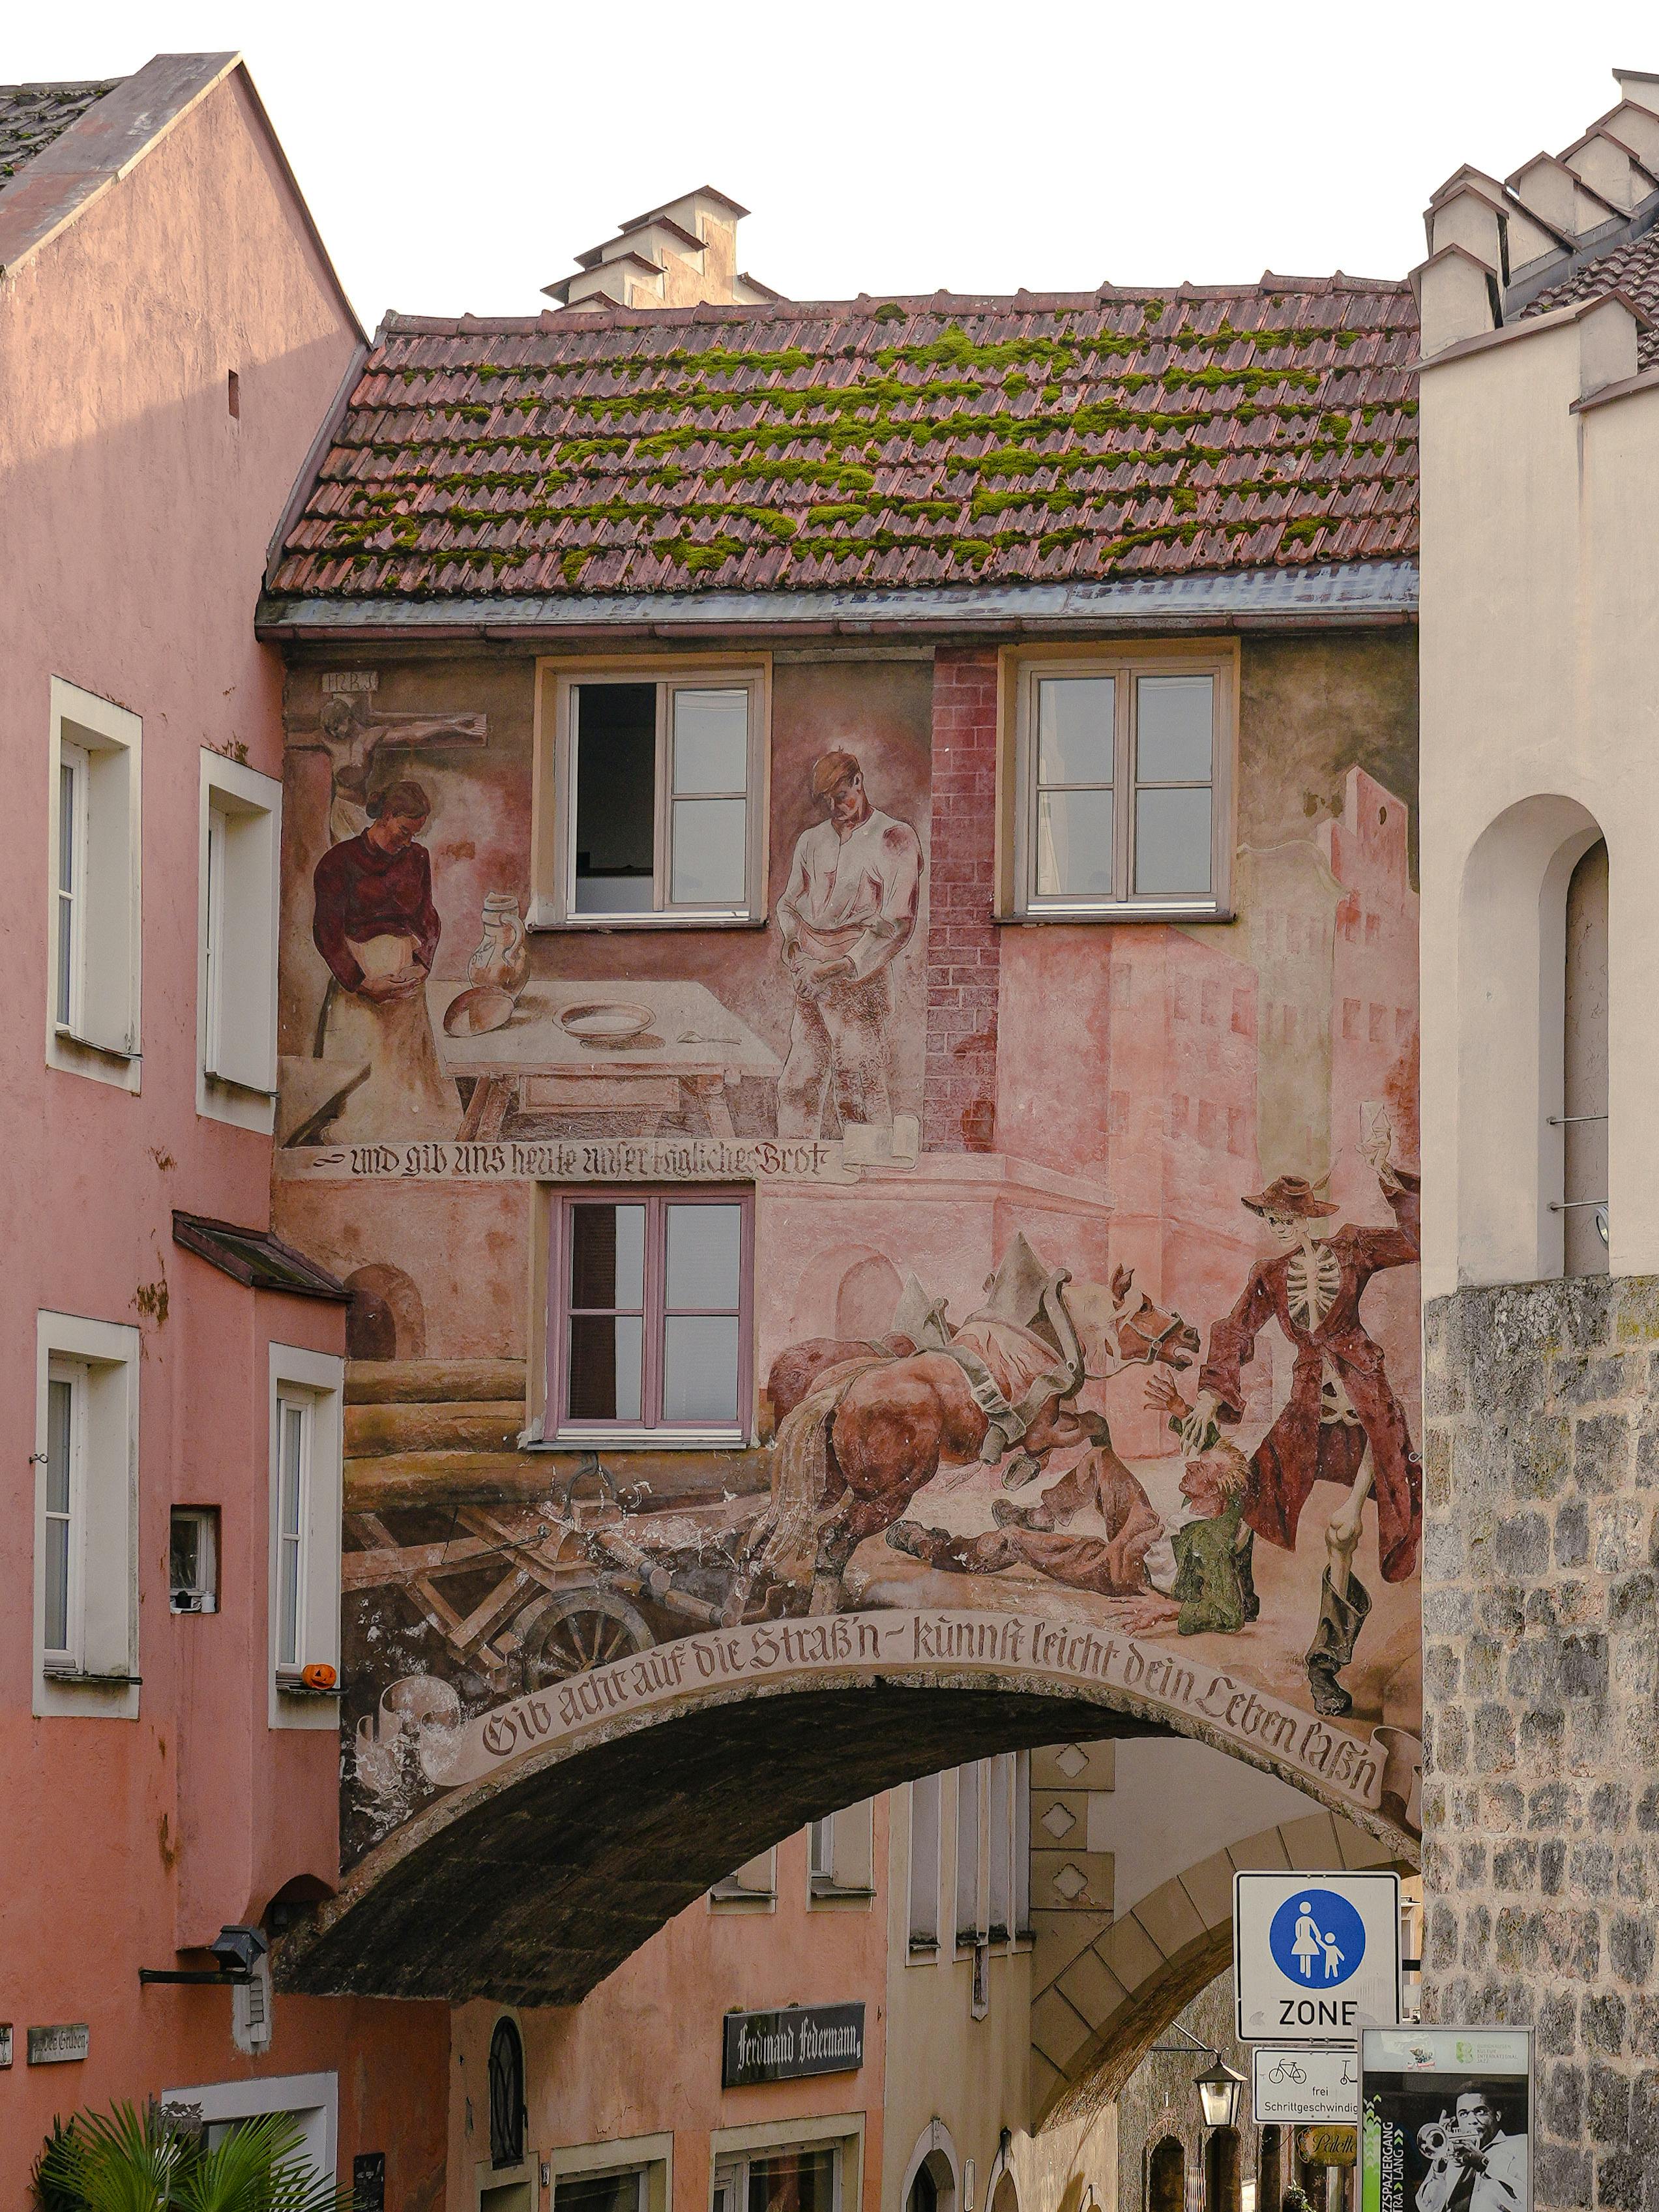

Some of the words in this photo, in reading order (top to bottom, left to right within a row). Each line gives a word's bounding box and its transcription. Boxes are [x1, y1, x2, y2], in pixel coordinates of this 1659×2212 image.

[350, 1145, 400, 1174] und
[400, 1143, 448, 1177] gib
[455, 1145, 505, 1174] uns
[510, 1143, 577, 1175] heute
[755, 1142, 830, 1175] Brot
[482, 1700, 551, 1756] Gib
[558, 1669, 627, 1726] acht
[691, 1636, 746, 1677] die
[1031, 1621, 1120, 1677] leicht
[1123, 1642, 1195, 1705] dein
[1195, 1677, 1297, 1753] Leben
[1280, 2000, 1357, 2026] ZONE
[737, 2022, 795, 2072] Ferdinand
[1312, 2086, 1329, 2096] frei
[1393, 2149, 1404, 2181] LANG
